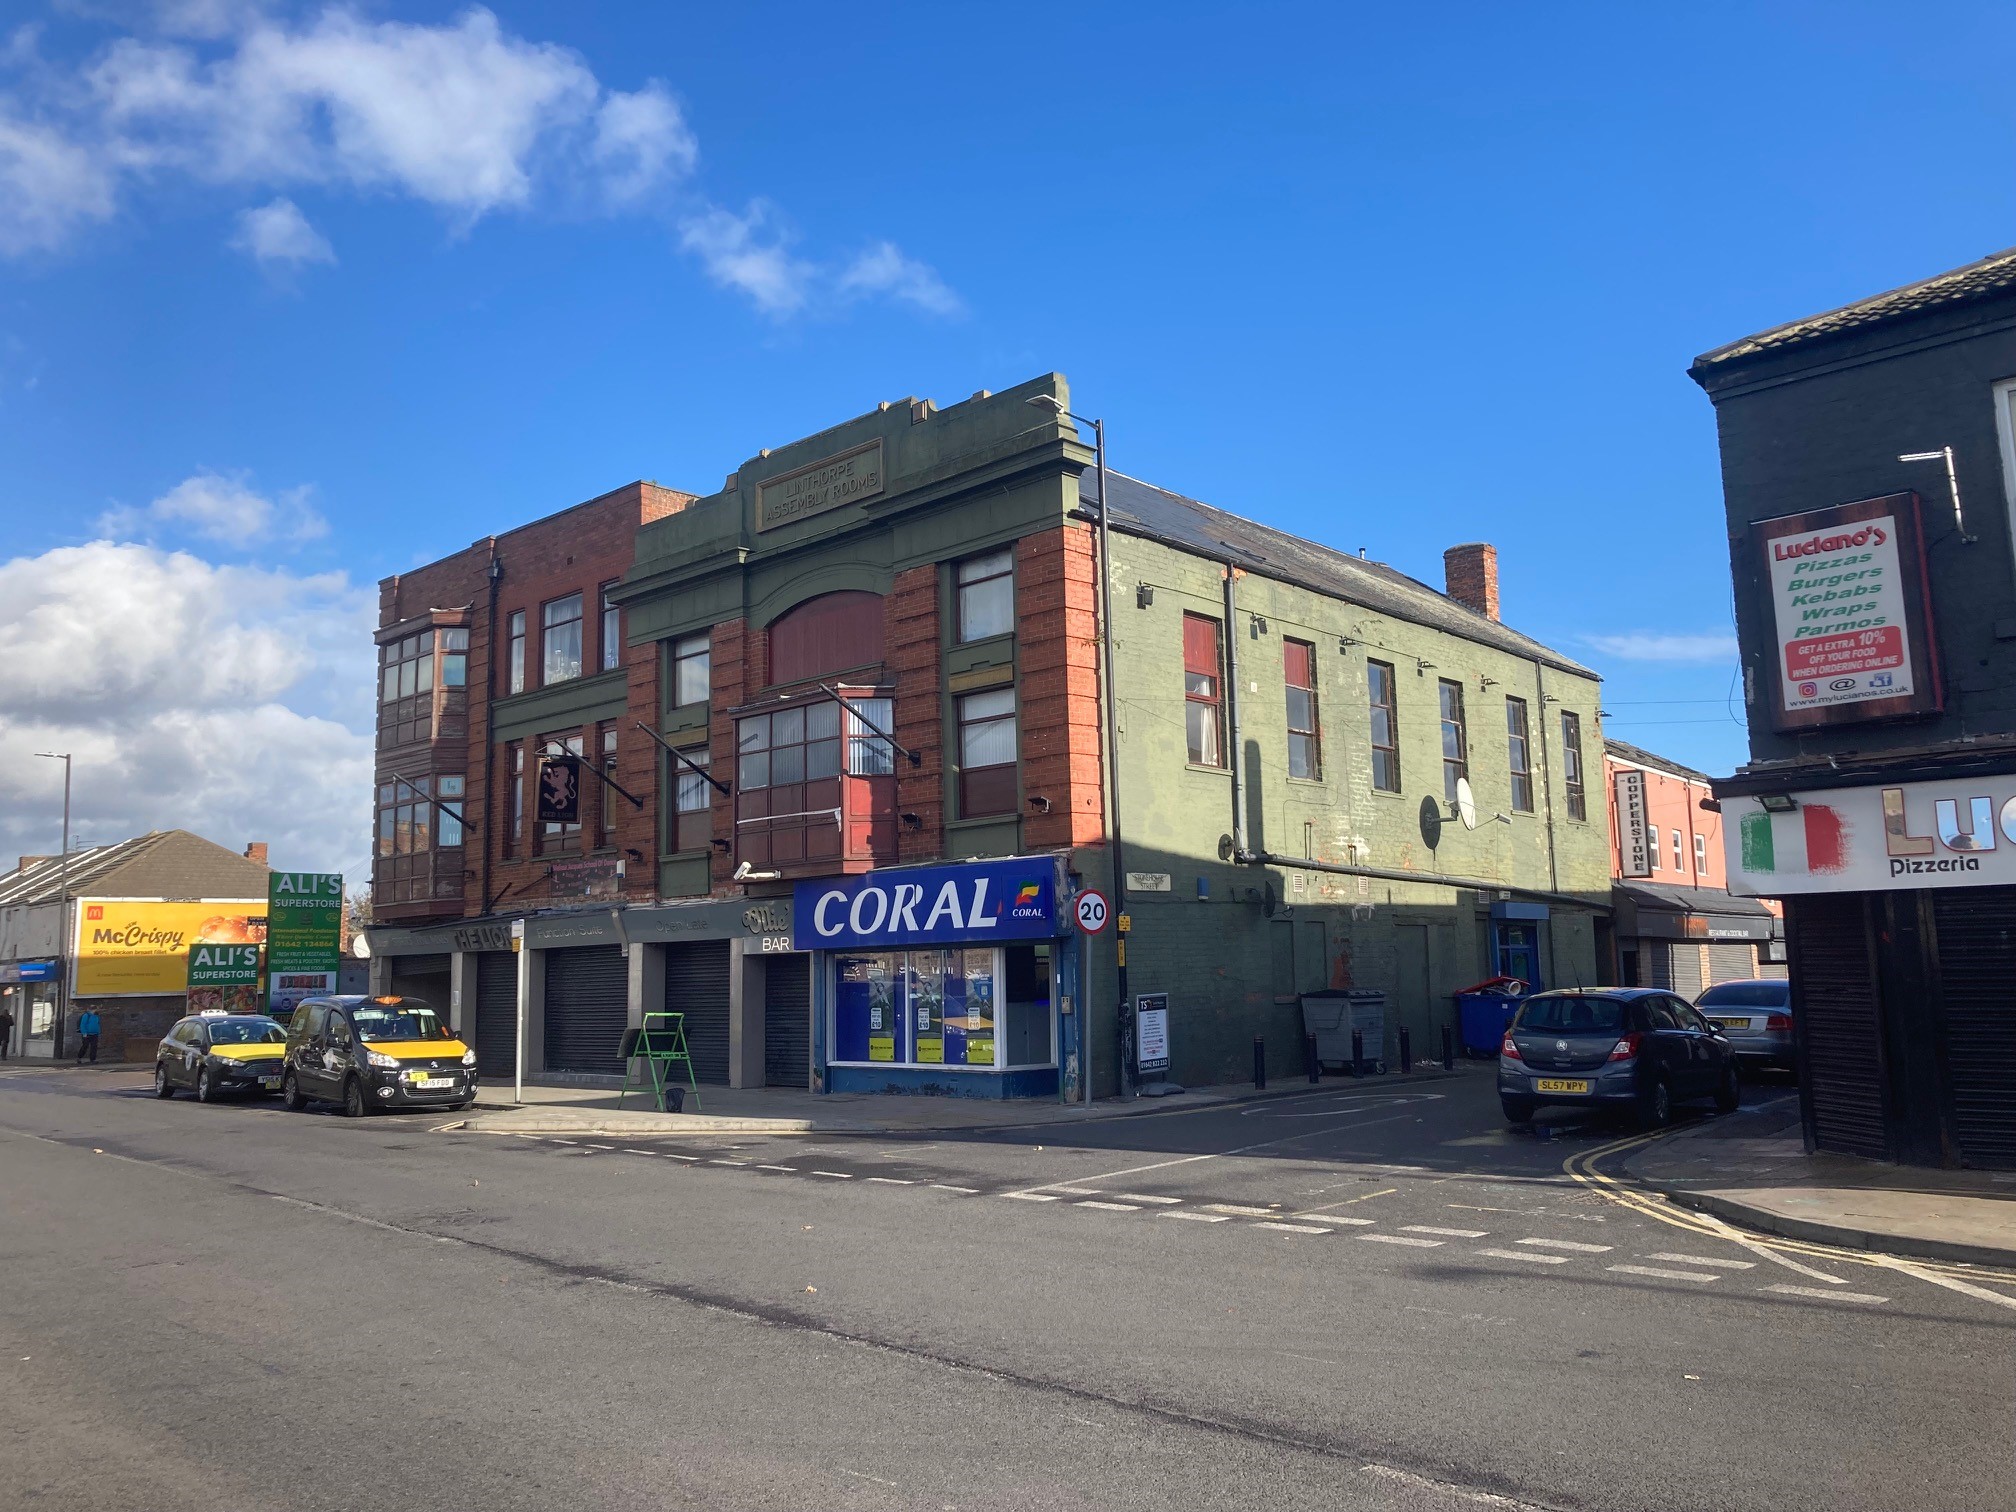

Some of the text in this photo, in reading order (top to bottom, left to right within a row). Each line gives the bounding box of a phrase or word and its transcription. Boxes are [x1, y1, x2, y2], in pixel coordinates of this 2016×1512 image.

[785, 460, 854, 498] LINTHORPE
[767, 472, 878, 521] ASSEMBLY ROOMS
[1774, 525, 1887, 561] Luciano's
[1793, 553, 1873, 575] Pizzas
[1787, 567, 1883, 591] Burgers
[1791, 584, 1882, 607] Kebabs
[1802, 601, 1878, 621] Wraps
[1794, 616, 1886, 638] Parmos
[1798, 630, 1886, 655] GET A EXTRA 10%
[1792, 655, 1898, 678] WHEN ORDERING ONLINE
[1809, 647, 1876, 664] OFF YOUR FOOD
[1789, 685, 1909, 707] www.mylucianos.co.uk
[1627, 776, 1645, 871] COPPERSTONE
[1889, 855, 1980, 878] Pizzeria
[276, 874, 341, 895] ALI'S
[274, 899, 341, 908] SUPERSTORE
[813, 877, 998, 937] CORAL
[1012, 908, 1043, 917] CORAL
[1080, 902, 1105, 921] 20
[536, 926, 575, 939] Function
[579, 925, 603, 935] Suite
[656, 919, 708, 933] Open Late
[93, 927, 185, 951] McCrispy
[762, 937, 790, 951] BAR
[194, 947, 257, 966] ALI'S
[193, 970, 256, 979] SUPERSTORE
[1542, 1081, 1584, 1091] SL57 WPY
